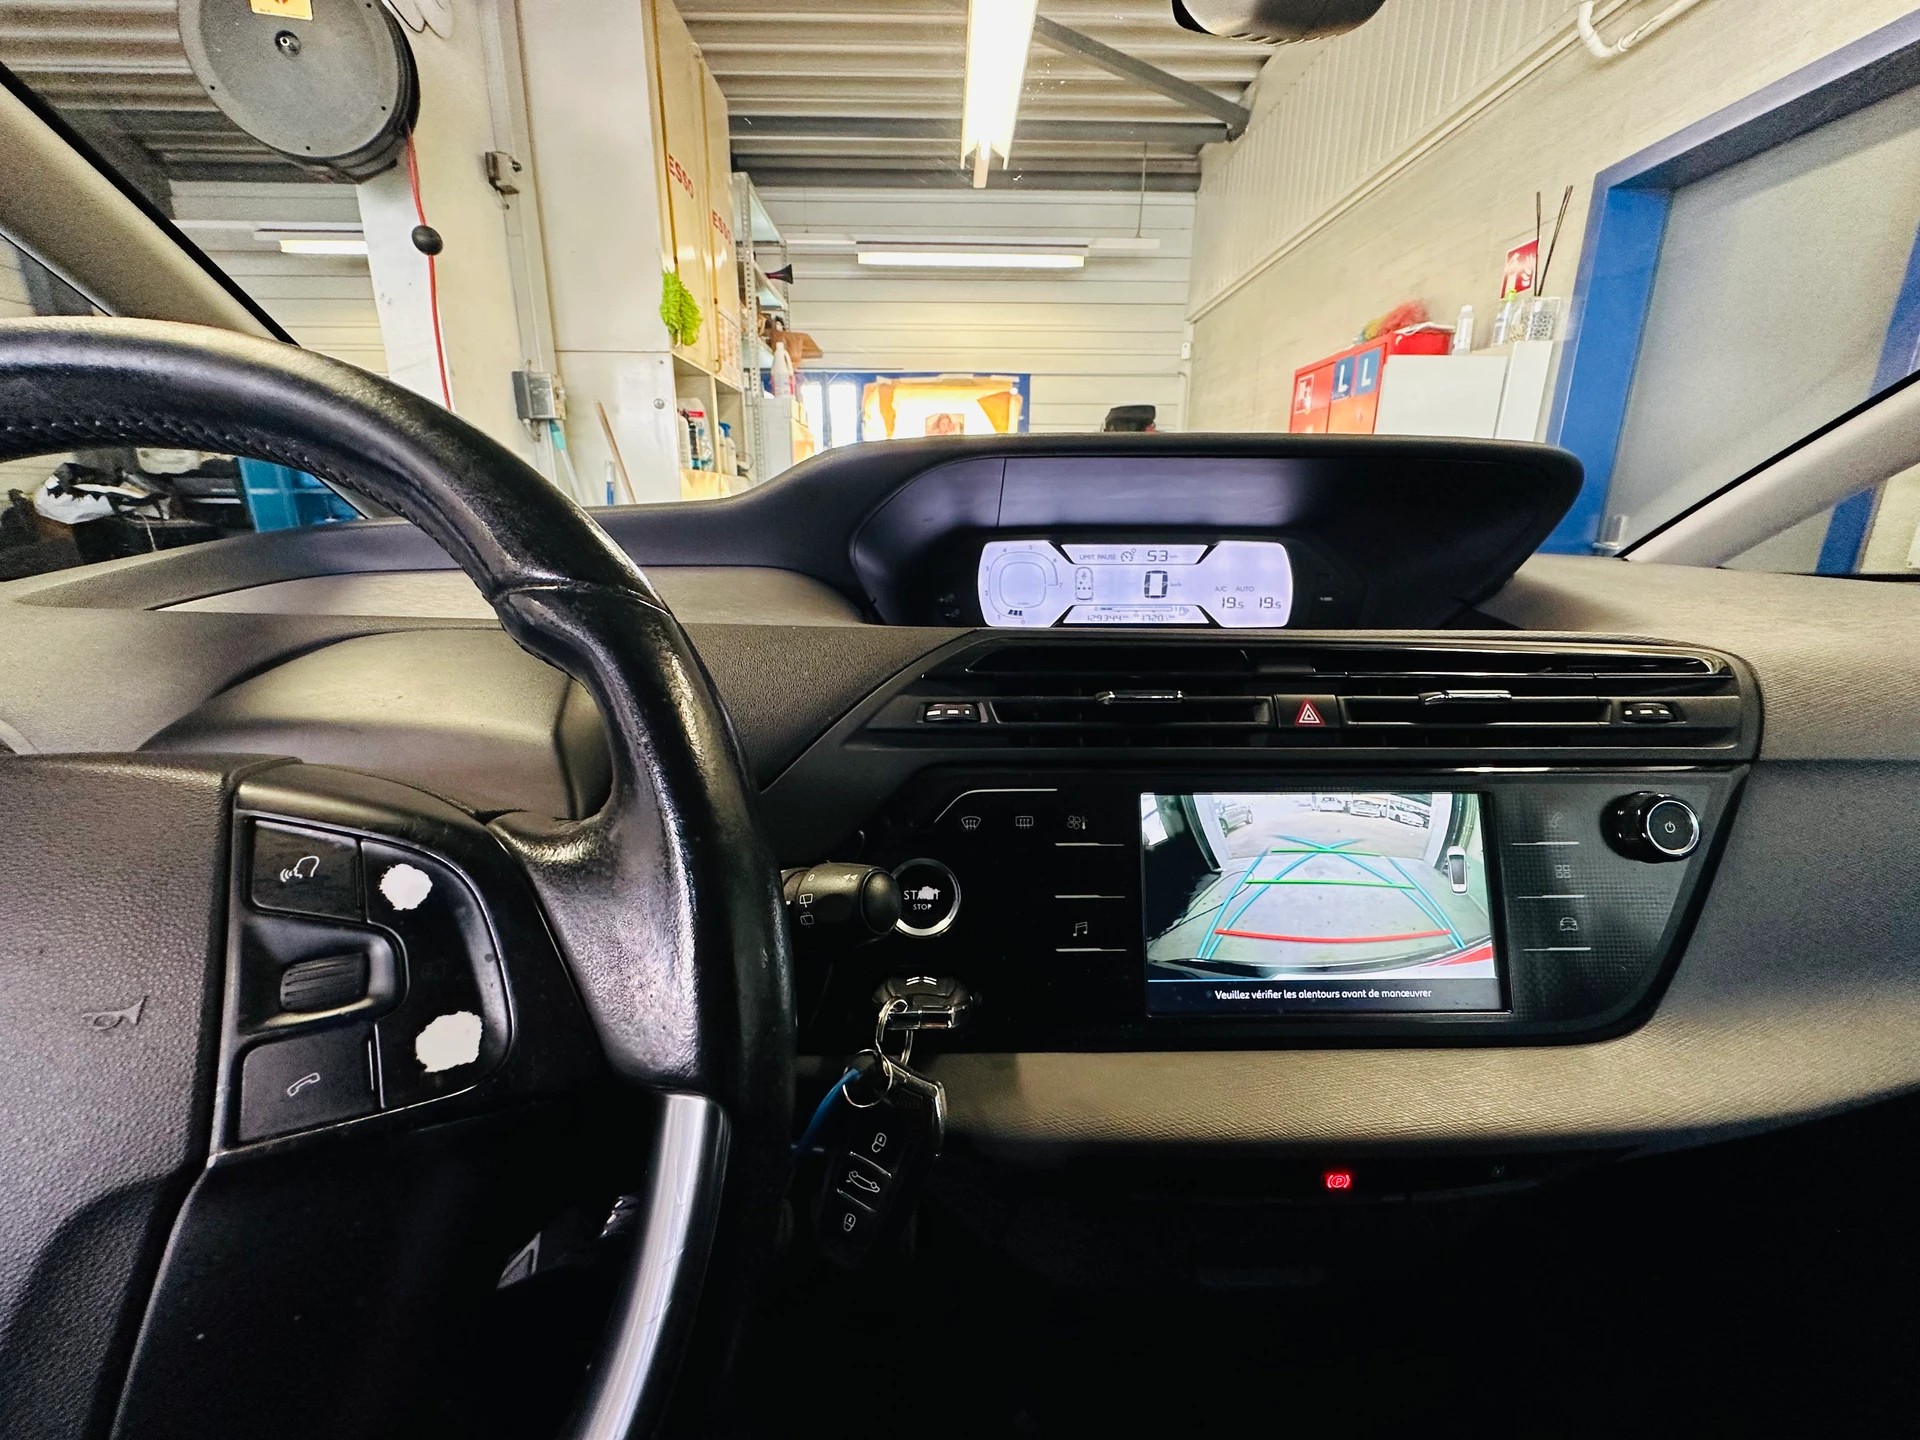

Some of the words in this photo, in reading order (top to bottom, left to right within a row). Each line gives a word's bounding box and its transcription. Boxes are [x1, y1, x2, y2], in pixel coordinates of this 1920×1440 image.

[668, 153, 694, 200] ESSO
[1338, 364, 1349, 392] L
[1361, 358, 1372, 387] L
[1147, 549, 1168, 562] 53
[1144, 570, 1168, 599] 0
[903, 888, 941, 900] STT
[912, 903, 932, 911] STOP
[1214, 990, 1250, 1000] Veuillez
[1251, 989, 1282, 999] vérifier
[1283, 989, 1297, 999] les
[1298, 989, 1341, 999] alentours
[1341, 989, 1367, 999] avant
[1368, 988, 1380, 998] de
[1381, 990, 1432, 998] manœuvrer
